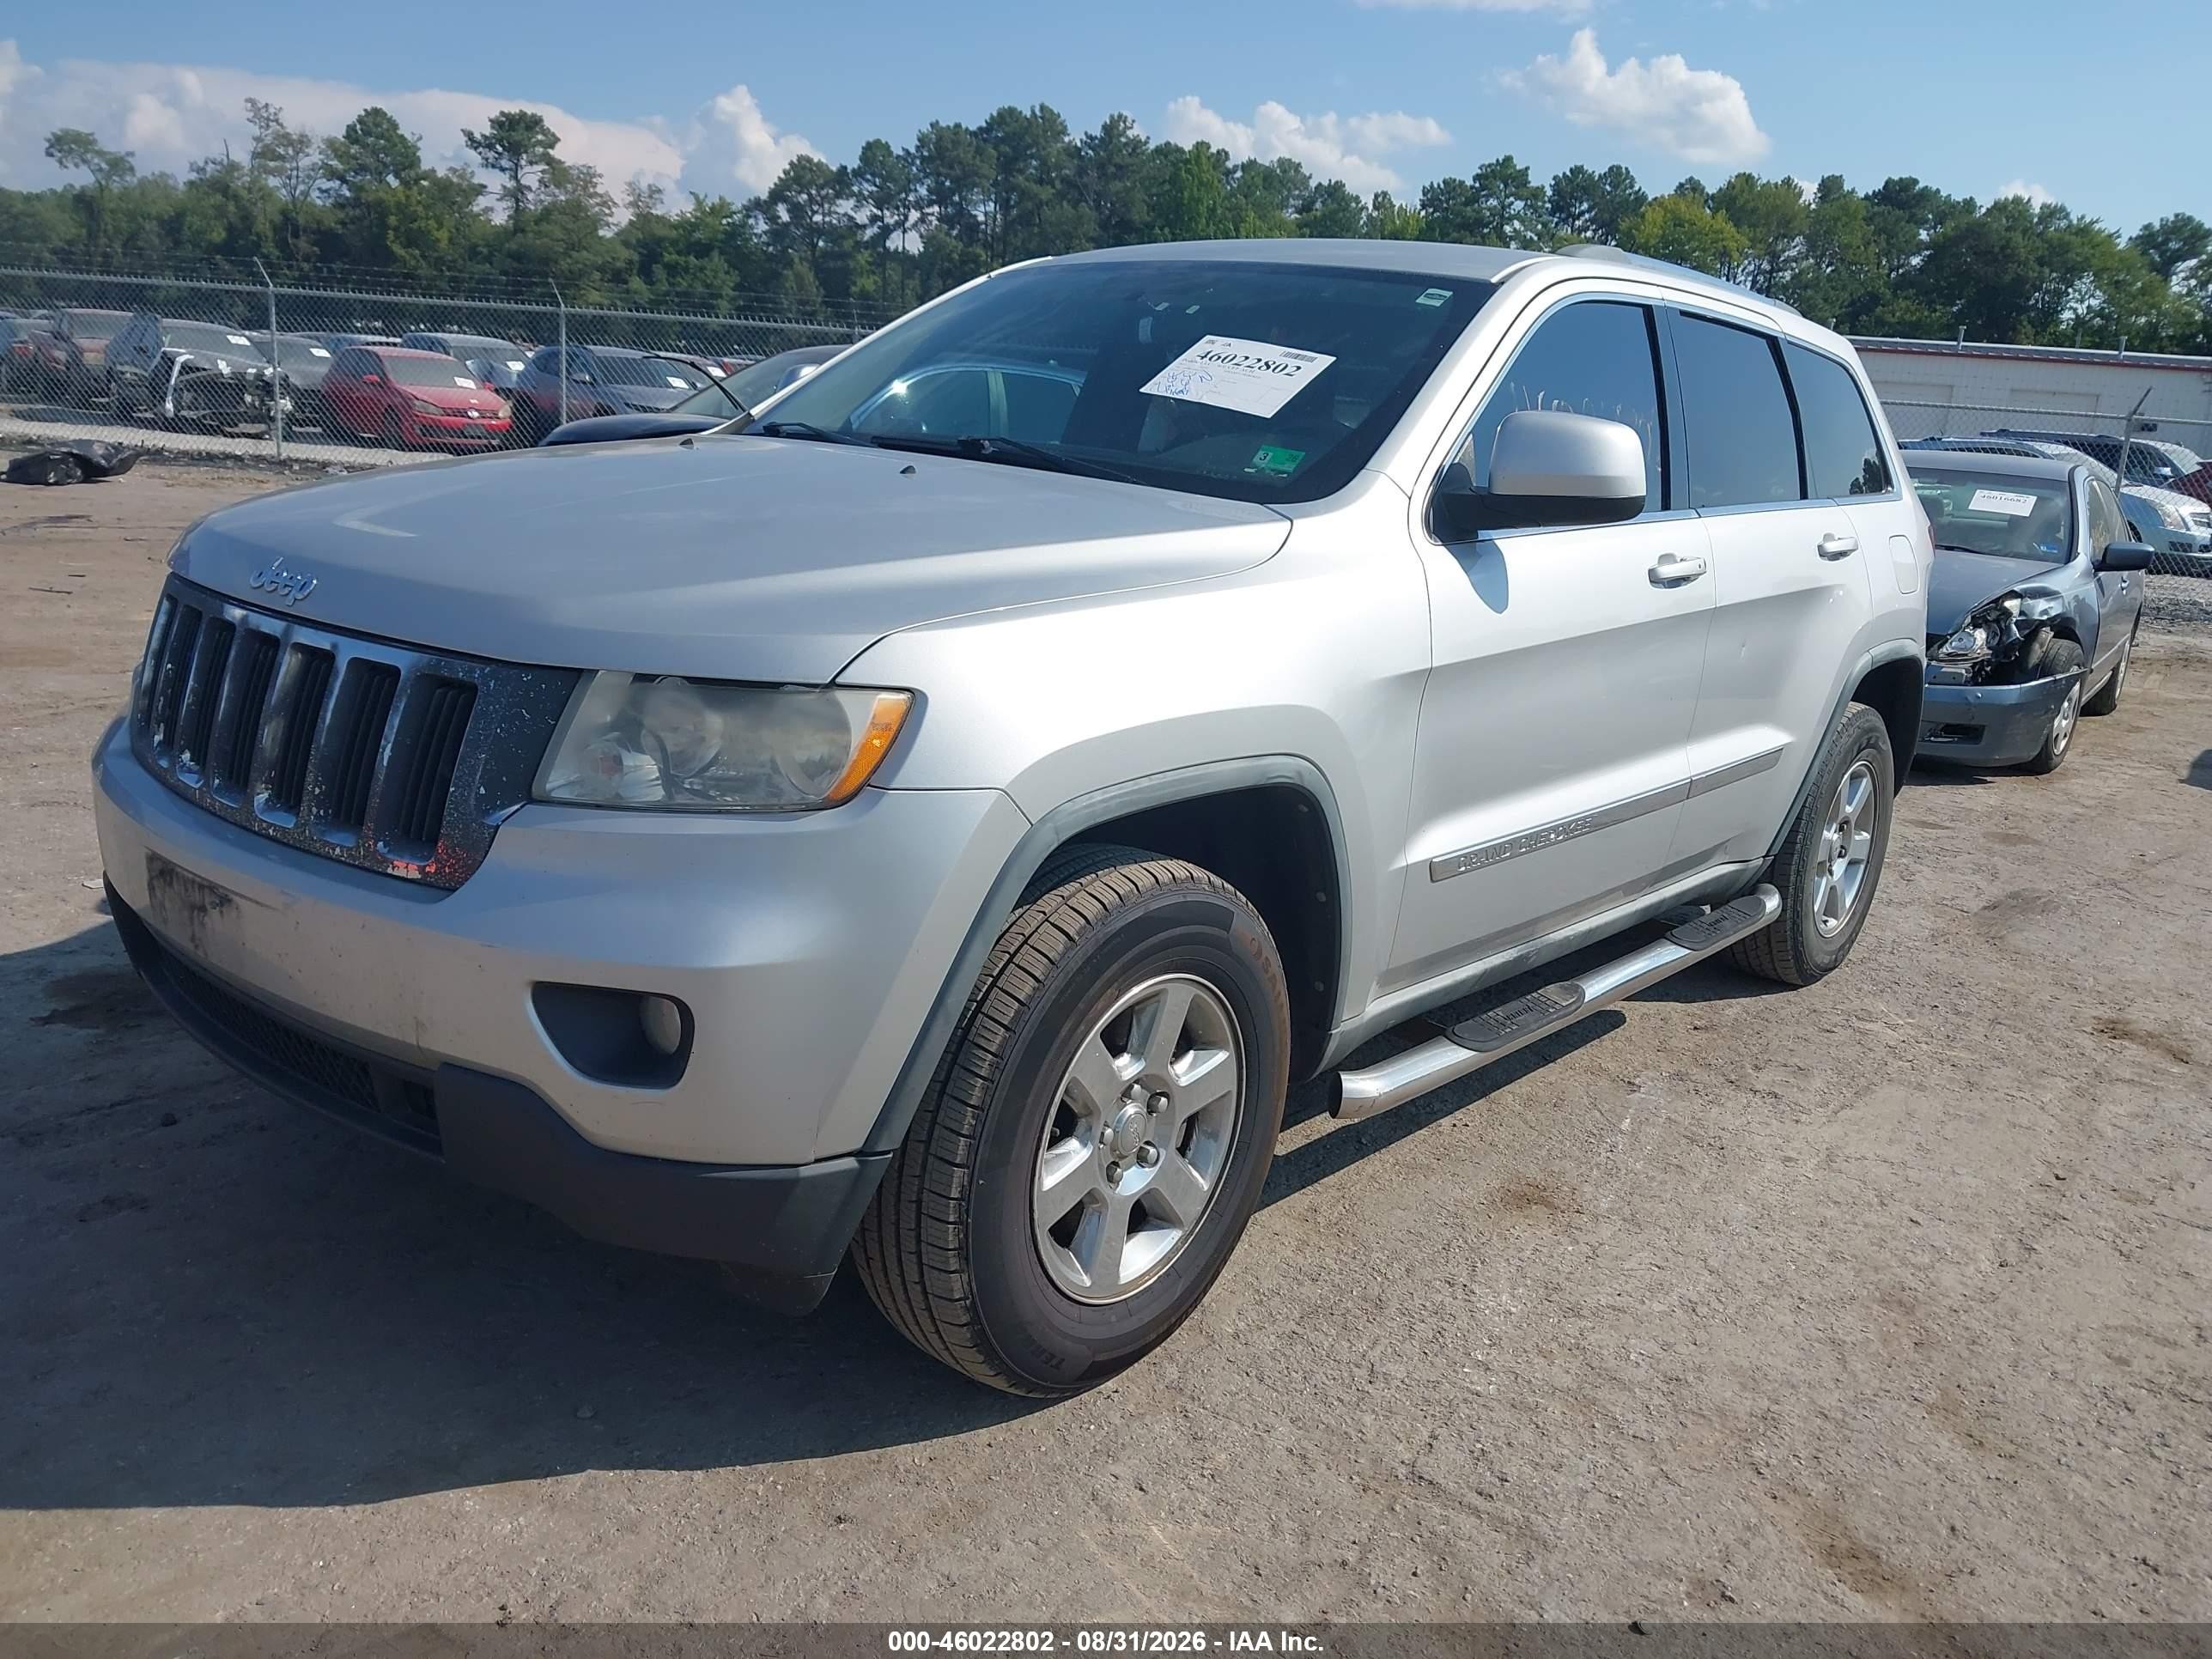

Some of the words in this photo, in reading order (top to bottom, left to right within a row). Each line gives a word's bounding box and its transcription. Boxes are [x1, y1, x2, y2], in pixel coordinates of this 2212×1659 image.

[1196, 349, 1303, 377] 46022802
[1259, 453, 1269, 461] 3
[250, 556, 318, 607] Jeep
[1457, 842, 1514, 872] GRAND
[1518, 817, 1593, 853] CHEROKEE
